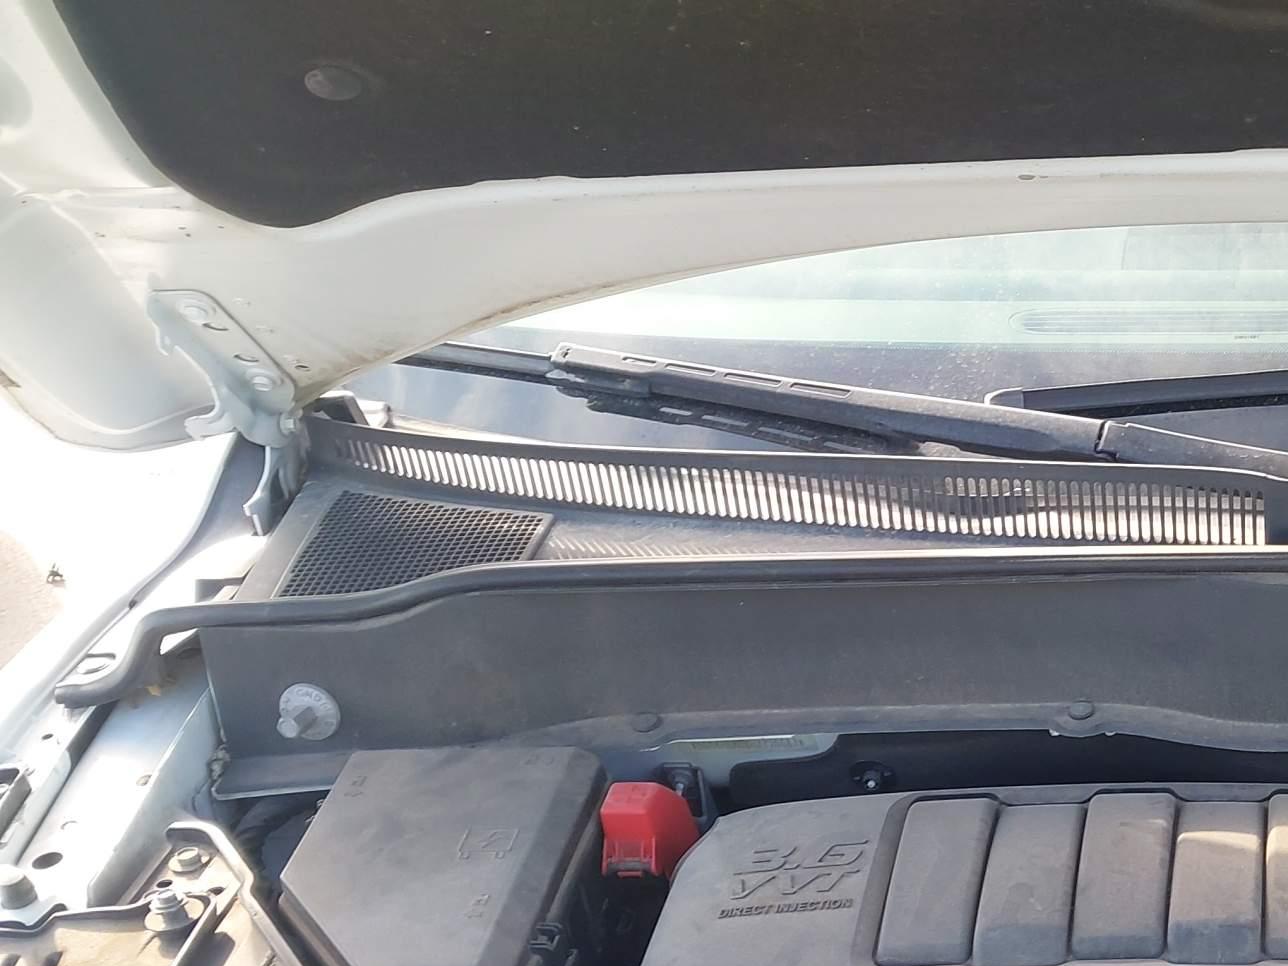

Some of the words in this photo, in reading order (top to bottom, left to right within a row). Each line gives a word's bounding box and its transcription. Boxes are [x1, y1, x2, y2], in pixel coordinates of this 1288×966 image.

[733, 839, 870, 876] 3.6
[729, 869, 861, 901] VVT
[718, 904, 773, 919] DIRECT
[775, 898, 853, 914] INJECTION
